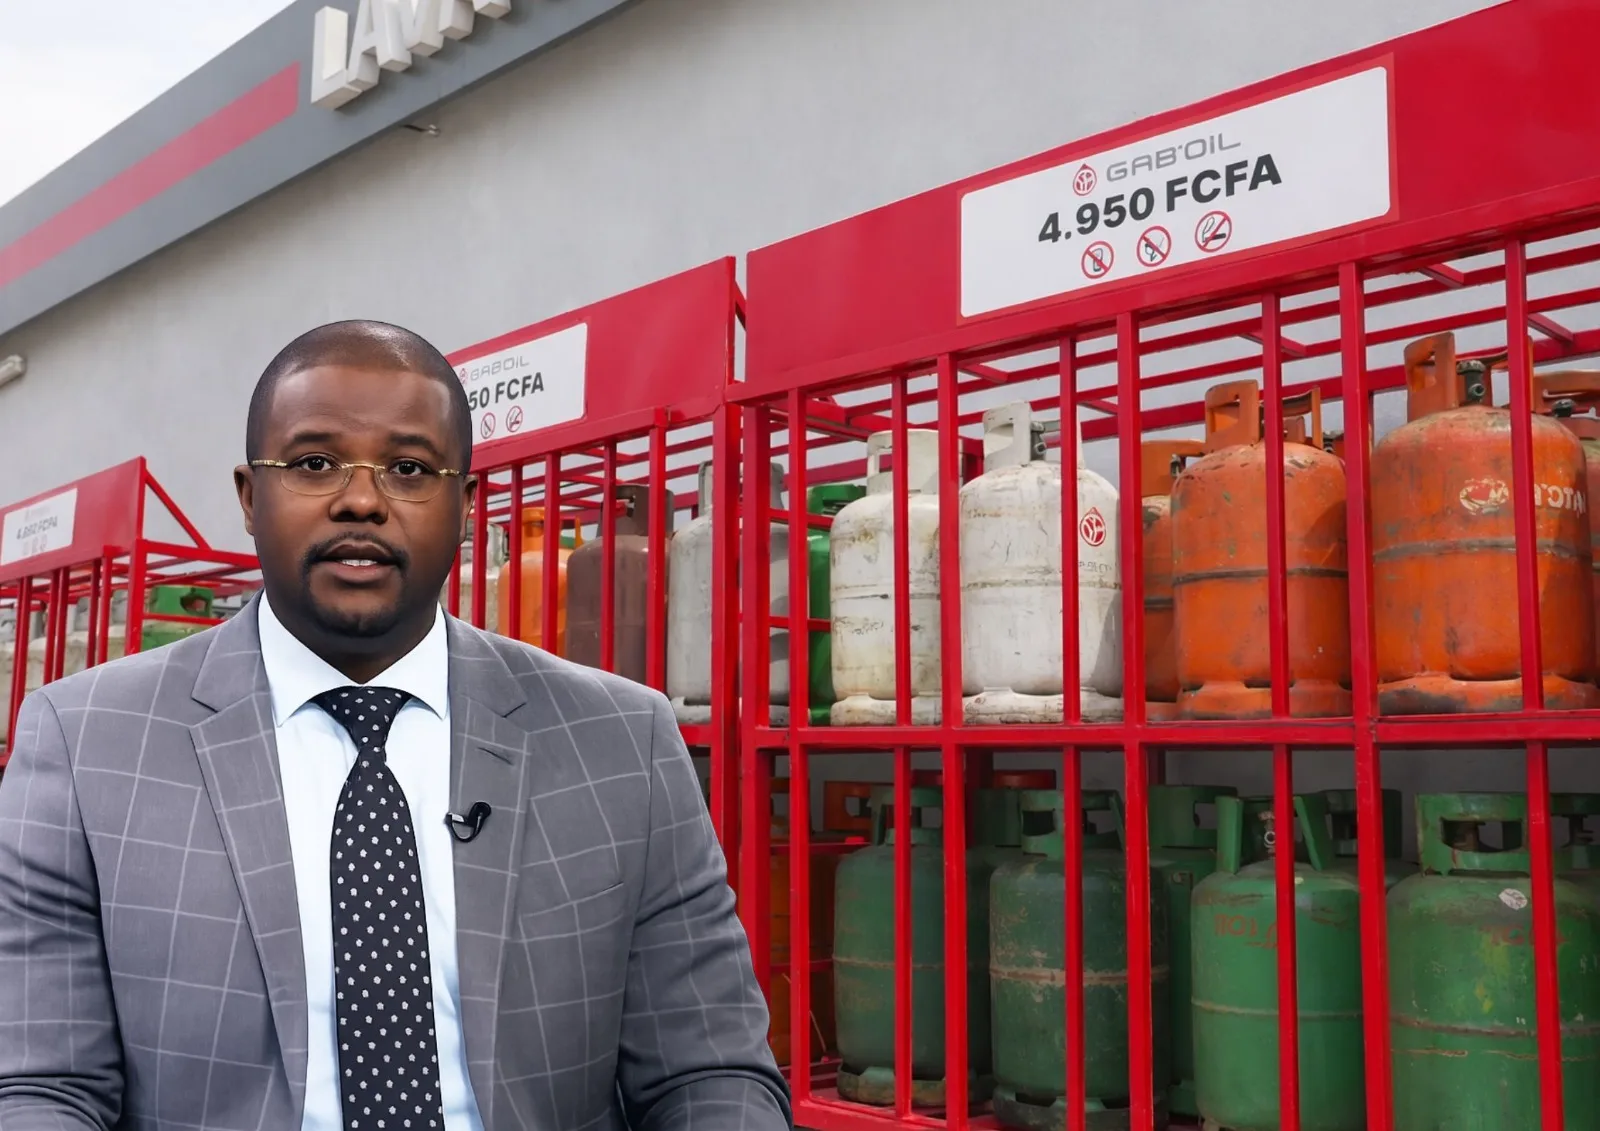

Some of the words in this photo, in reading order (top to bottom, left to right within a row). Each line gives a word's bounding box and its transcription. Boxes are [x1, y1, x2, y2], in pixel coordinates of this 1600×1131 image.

[1038, 186, 1155, 243] 4.950
[1165, 153, 1283, 213] FCFA
[494, 371, 545, 404] FCFA
